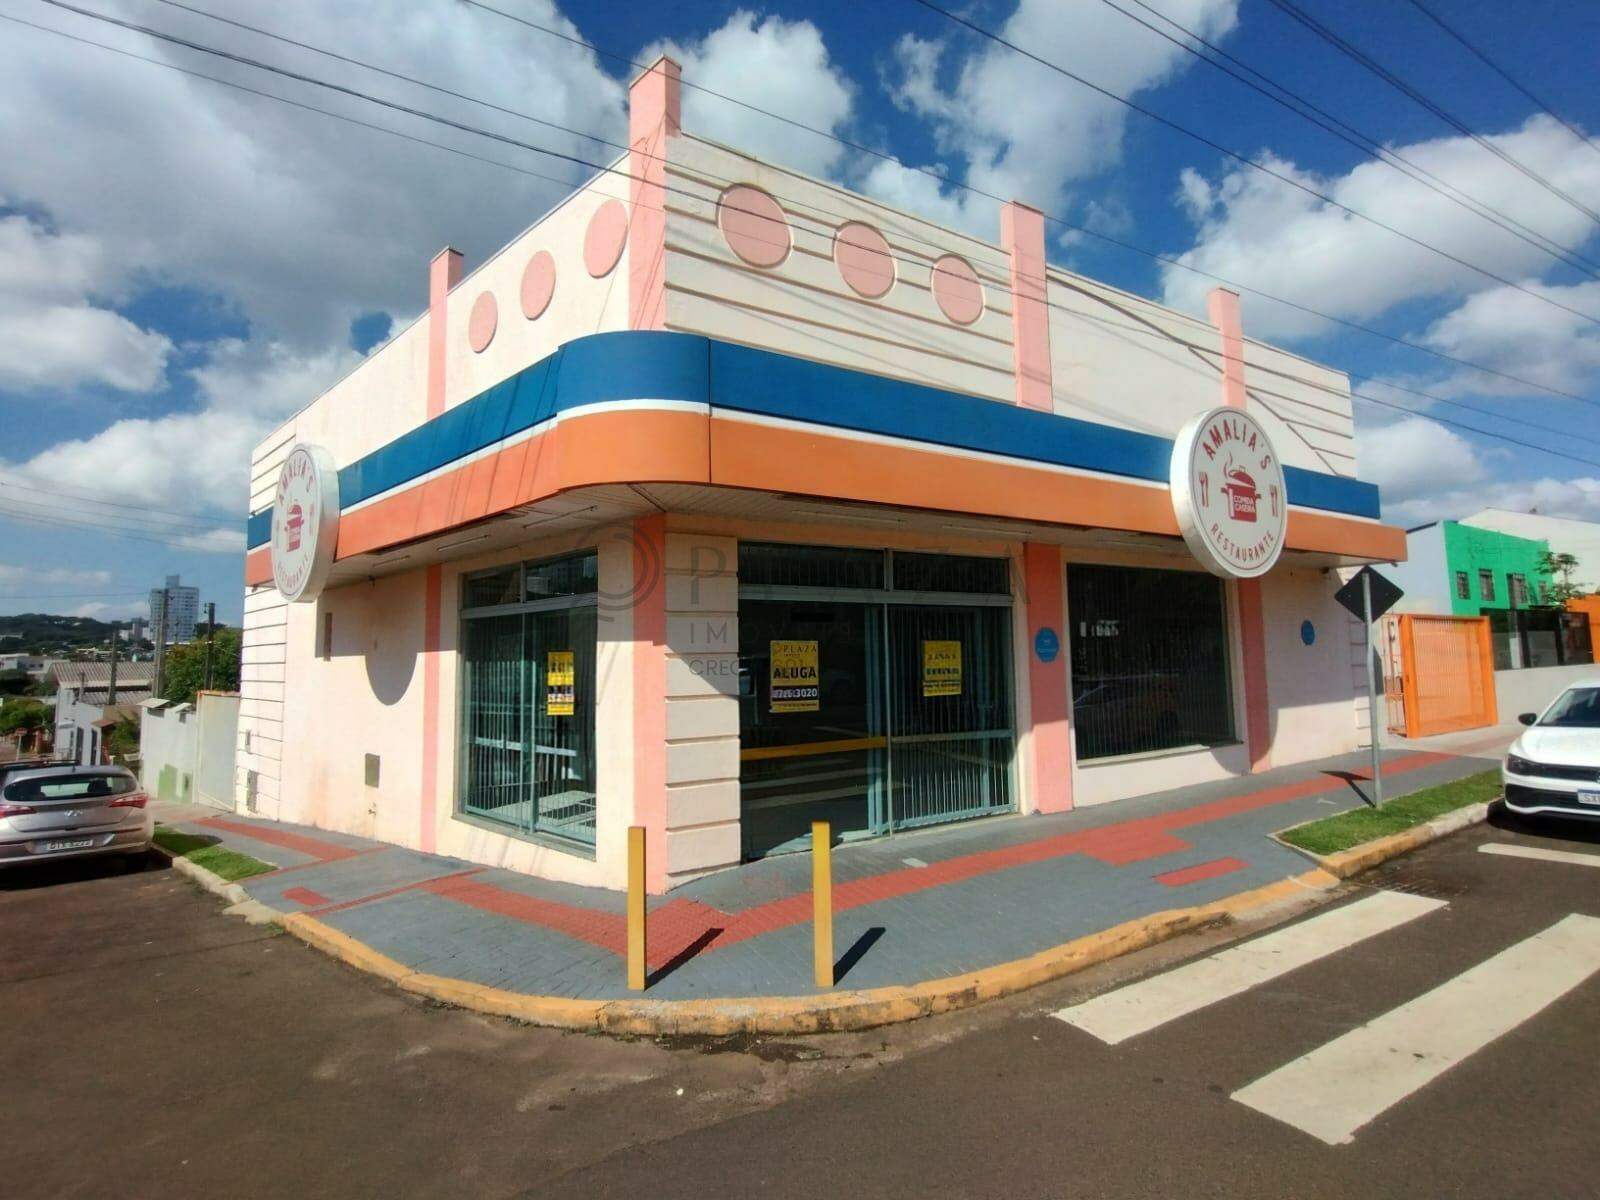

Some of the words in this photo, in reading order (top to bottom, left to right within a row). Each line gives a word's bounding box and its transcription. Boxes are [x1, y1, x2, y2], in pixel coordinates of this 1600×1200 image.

[1202, 418, 1272, 471] AMALIA'S
[1210, 522, 1275, 564] RESTAURANTE
[773, 666, 817, 679] ALUGA
